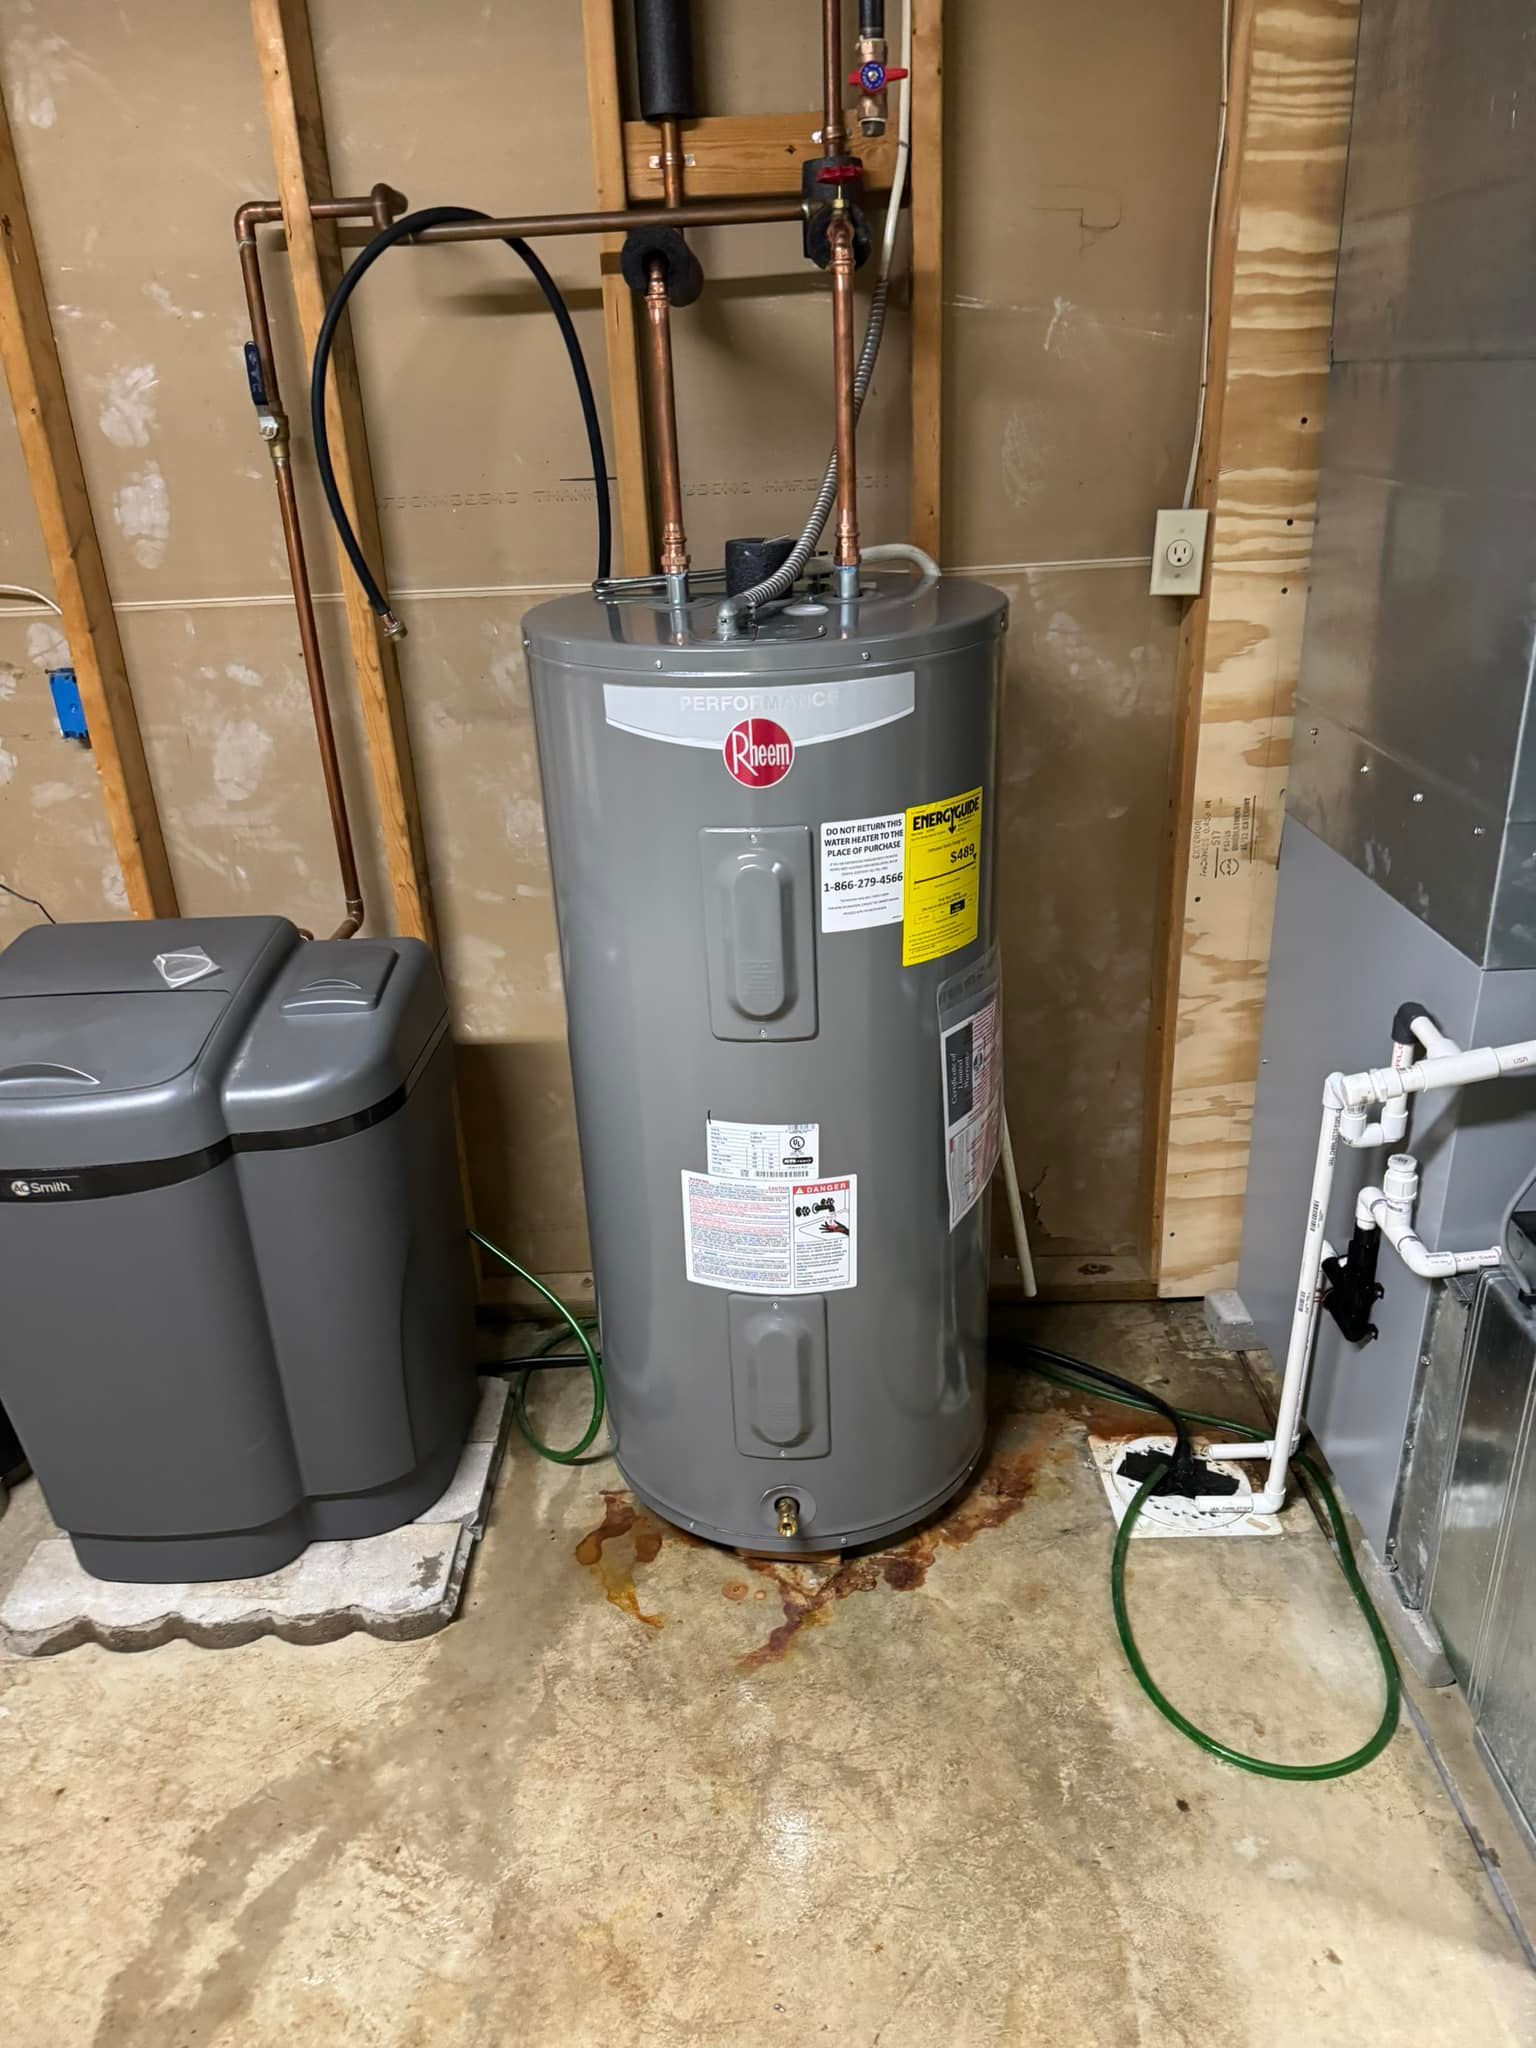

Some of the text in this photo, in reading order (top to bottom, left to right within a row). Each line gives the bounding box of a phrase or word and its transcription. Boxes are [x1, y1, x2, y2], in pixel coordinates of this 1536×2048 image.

[679, 691, 840, 712] PERFORMANCE
[731, 719, 790, 776] Rheem
[913, 797, 980, 832] ENERGYGUIDE
[826, 819, 902, 836] DO NOT RETURN THIS
[824, 838, 850, 847] WATER
[851, 833, 879, 845] HEATER
[880, 832, 890, 840] TO
[890, 829, 904, 838] THE
[827, 841, 901, 857] PLACE OF PURCHASE
[824, 872, 903, 892] 1-866-279-4566
[30, 1182, 71, 1193] Smith
[806, 1183, 847, 1193] DANGER
